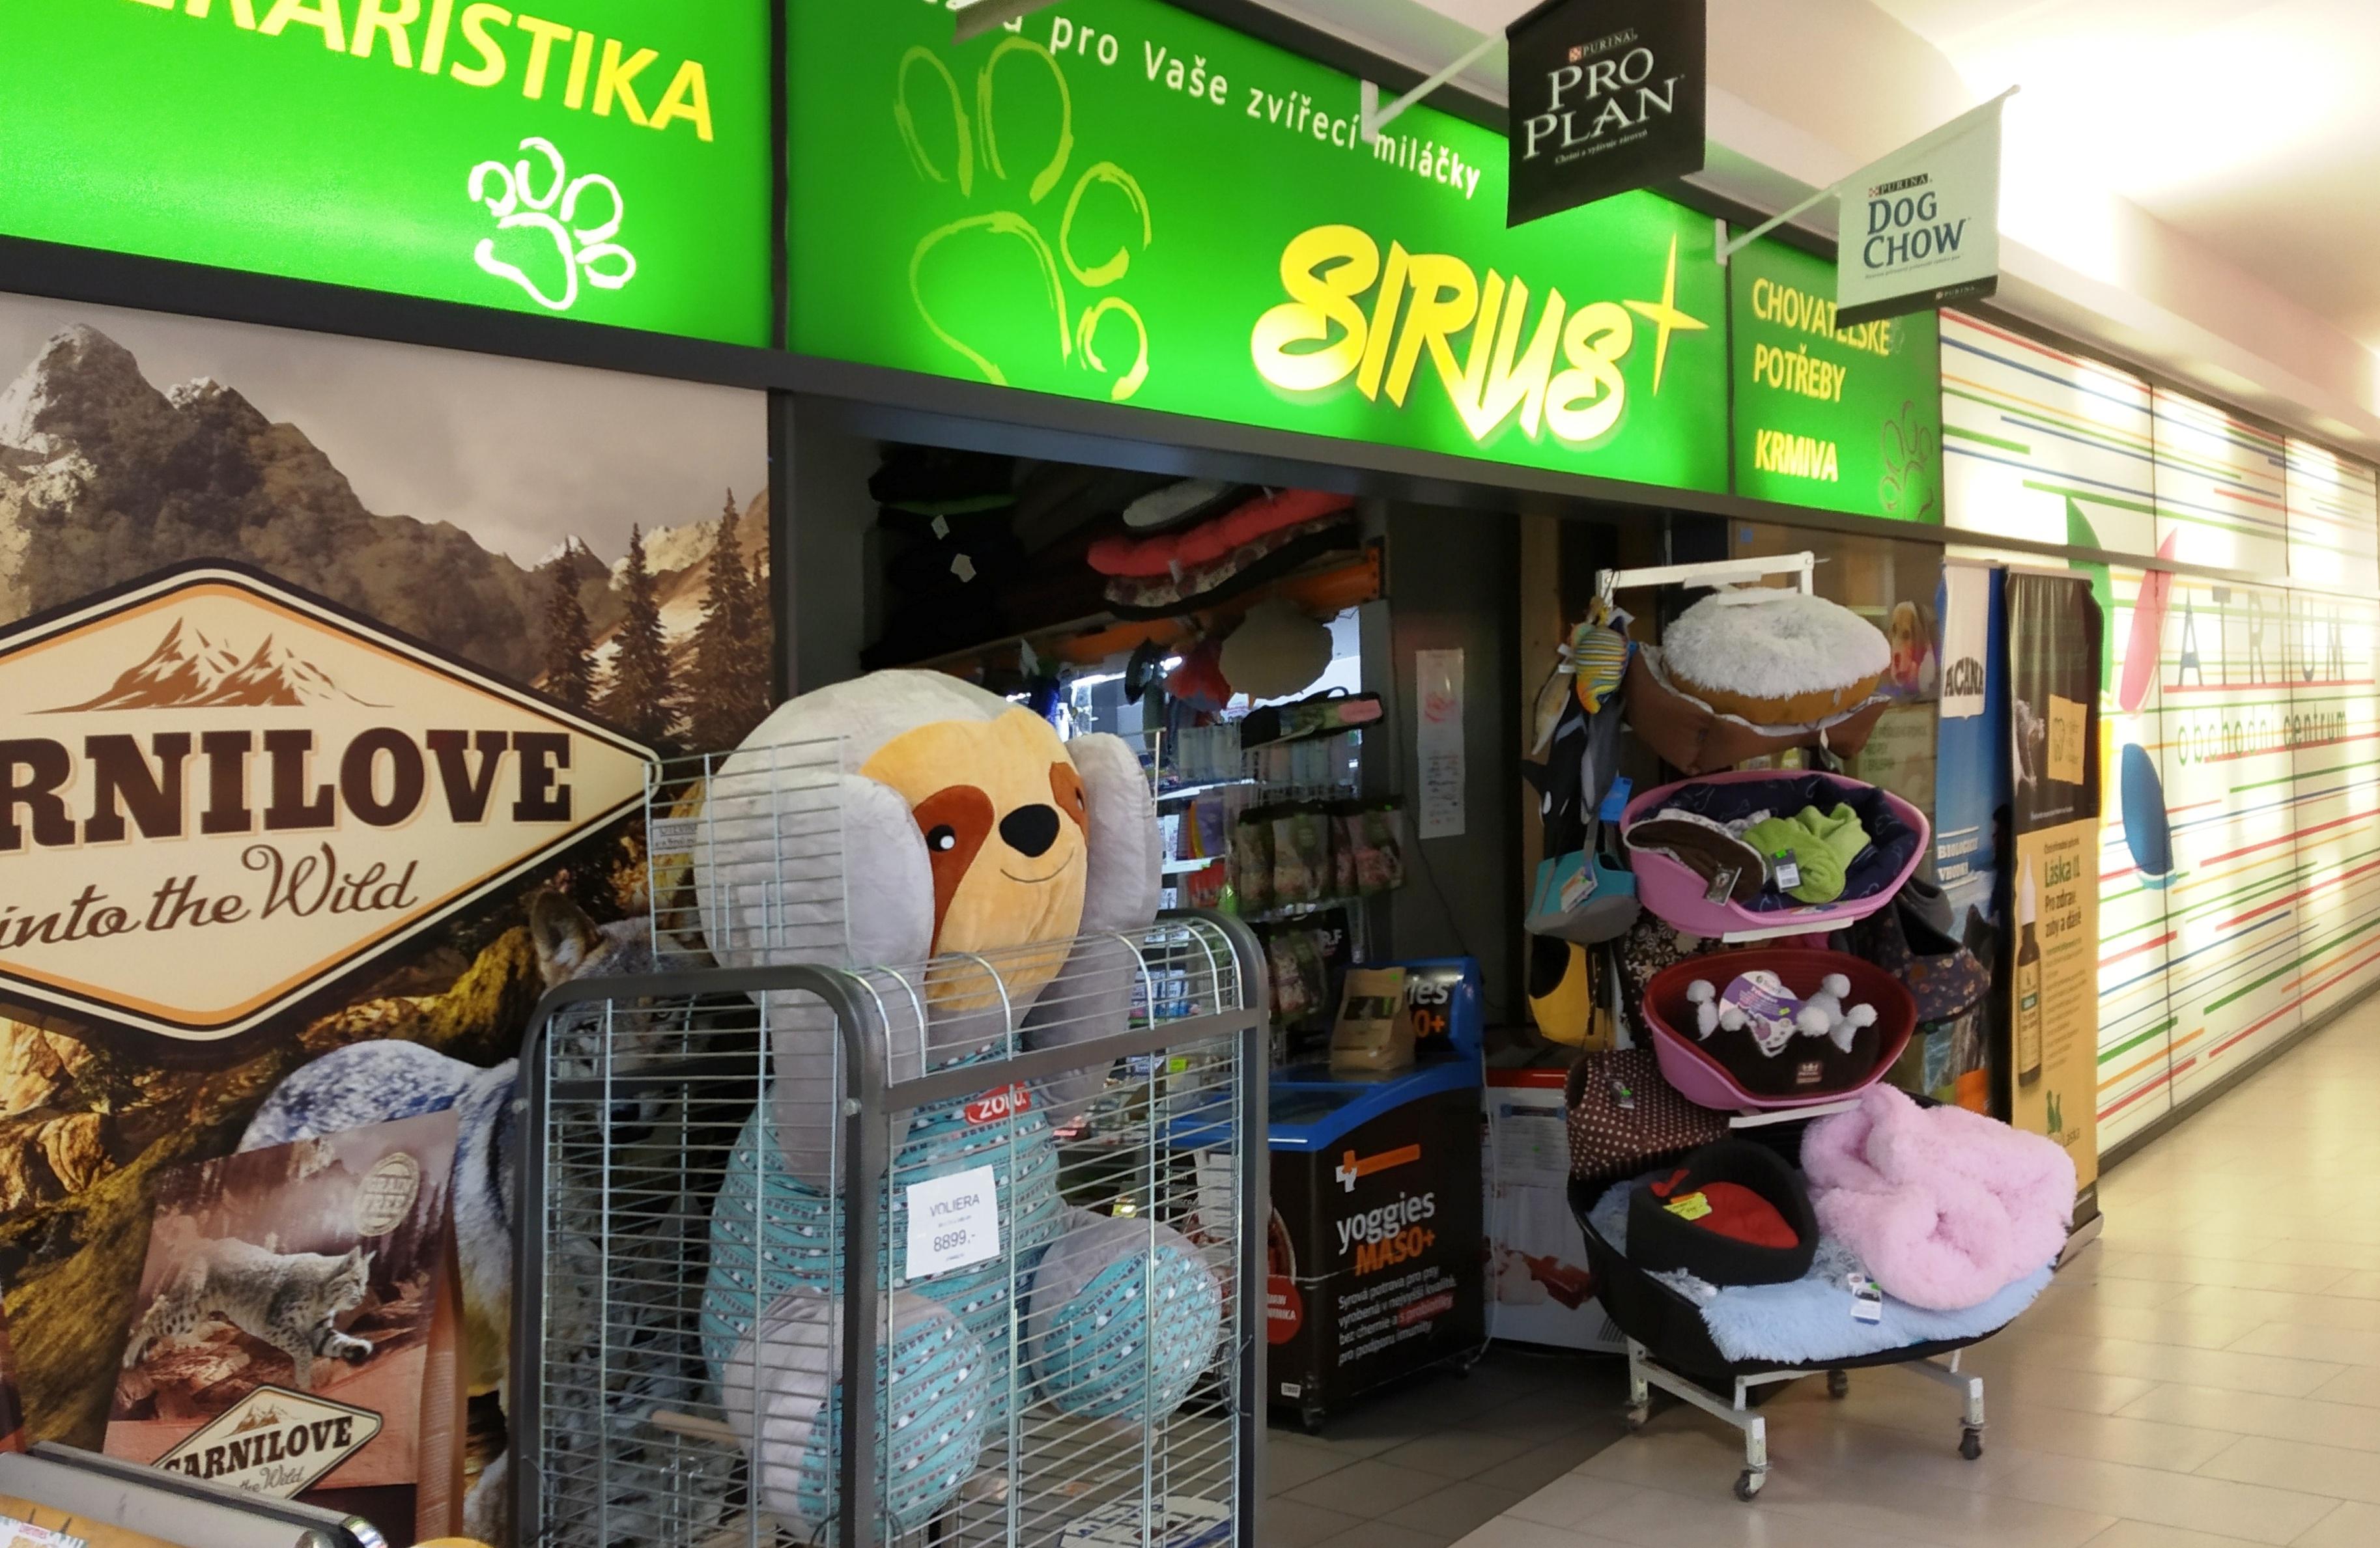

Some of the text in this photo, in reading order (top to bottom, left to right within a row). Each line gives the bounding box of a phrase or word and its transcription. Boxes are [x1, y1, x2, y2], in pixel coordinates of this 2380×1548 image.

[134, 0, 714, 141] ARISTIKA
[1583, 33, 1632, 55] PURINA
[1050, 15, 1119, 66] pro
[1145, 40, 1228, 105] Vaše
[1247, 87, 1360, 150] zvířecí
[1374, 132, 1480, 200] miláčky
[1548, 47, 1654, 112] PRO
[1523, 76, 1678, 160] PLAN
[1880, 174, 1928, 194] PURINA
[1867, 191, 1937, 235] DOG
[1863, 218, 1967, 269] CHOW
[1251, 224, 1634, 443] SIRIUS
[1753, 343, 1847, 402] POTŘEBY
[1755, 428, 1839, 483] KRMIVA
[2177, 585, 2346, 687] ATRIUM
[1944, 656, 1984, 697] ACANA
[2177, 703, 2347, 767] obchodní centrum
[0, 841, 419, 950] into the Wild
[929, 1194, 980, 1217] VOLIERA
[1336, 1191, 1436, 1256] yoggies
[933, 1229, 976, 1252] 8899,-
[1354, 1226, 1436, 1277] MASO+
[260, 1464, 306, 1490] Wild
